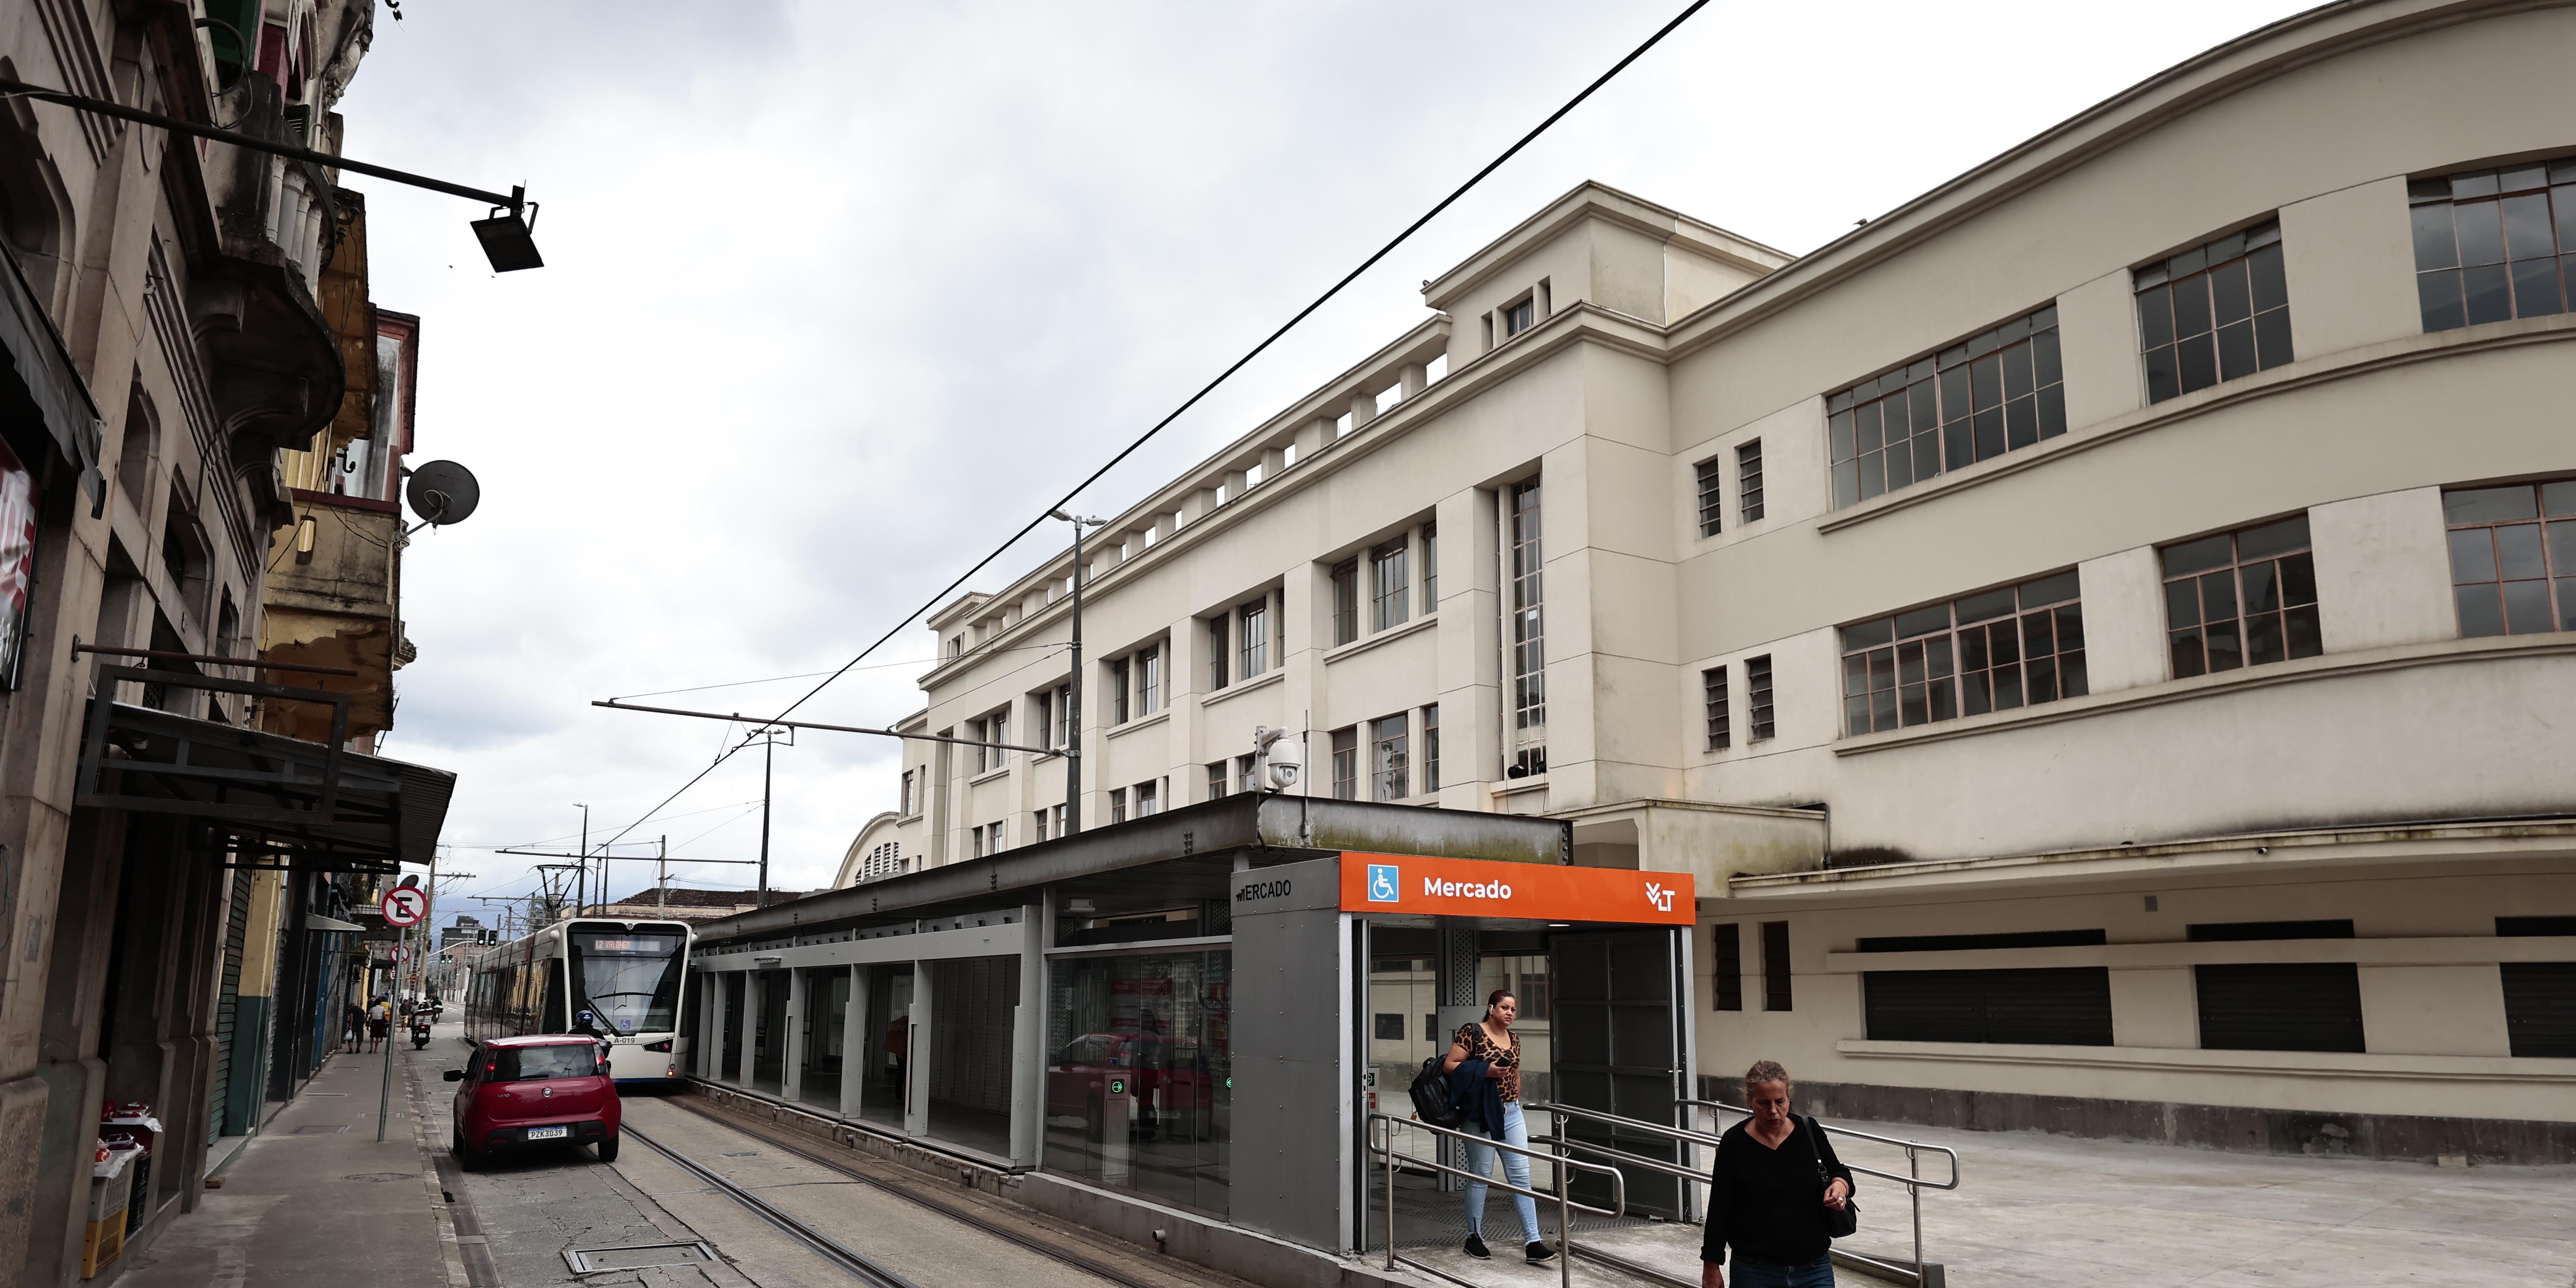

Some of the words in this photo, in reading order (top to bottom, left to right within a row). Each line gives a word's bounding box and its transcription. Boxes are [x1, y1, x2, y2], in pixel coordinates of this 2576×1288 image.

[1236, 880, 1291, 902] MERCADO
[1425, 877, 1511, 899] Mercado
[396, 897, 412, 918] E
[605, 941, 630, 949] VALONGO
[532, 1130, 562, 1138] PZK3D39
